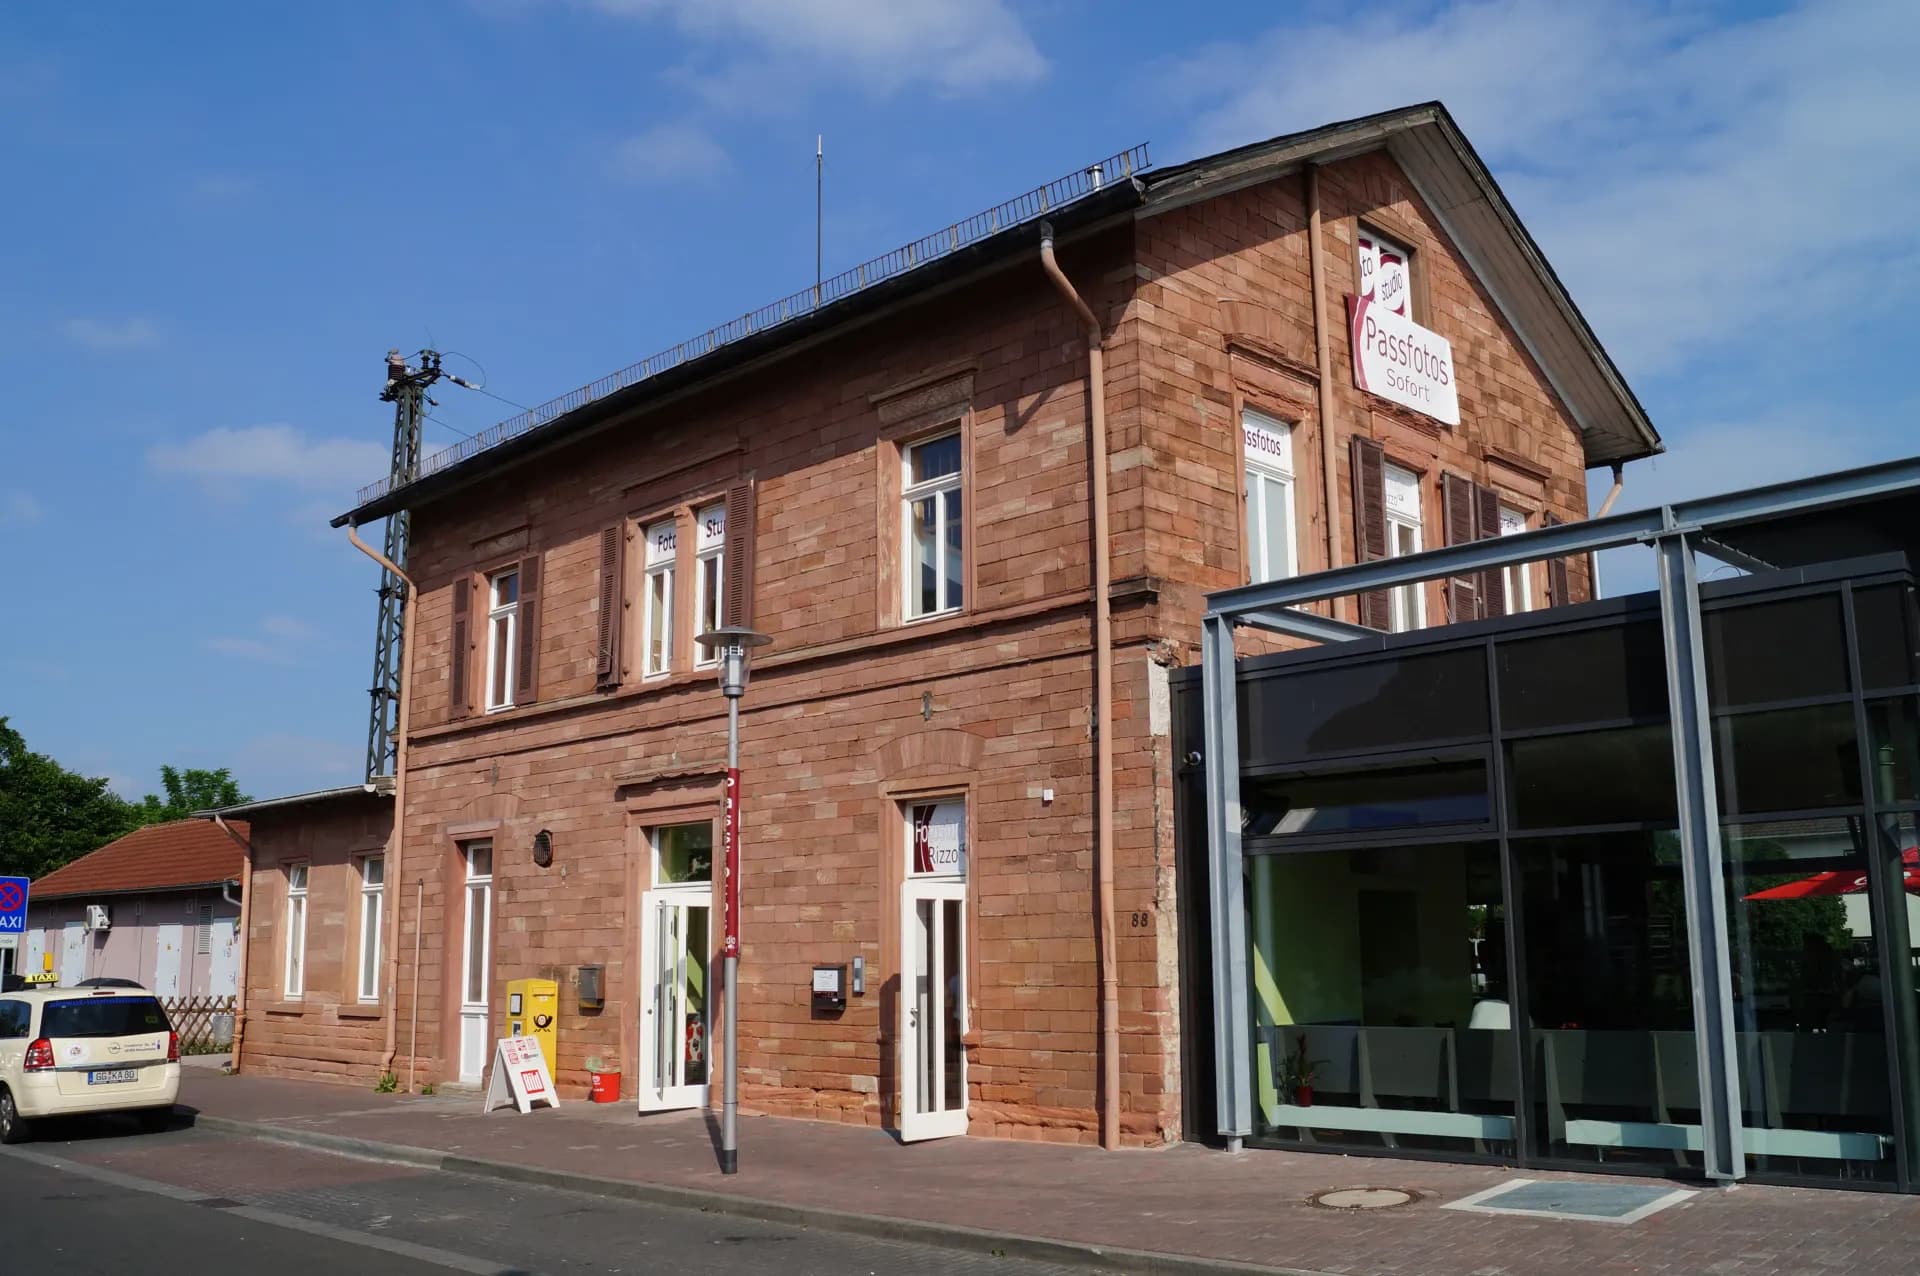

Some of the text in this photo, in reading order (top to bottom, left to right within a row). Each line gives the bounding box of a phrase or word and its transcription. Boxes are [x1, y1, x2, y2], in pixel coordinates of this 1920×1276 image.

[1360, 255, 1373, 278] to
[1381, 270, 1403, 301] studio
[1366, 315, 1449, 386] Passfotos
[1386, 368, 1430, 402] Sofort
[928, 845, 959, 865] Rizzo
[1131, 912, 1148, 928] 88
[33, 973, 56, 981] TAXI
